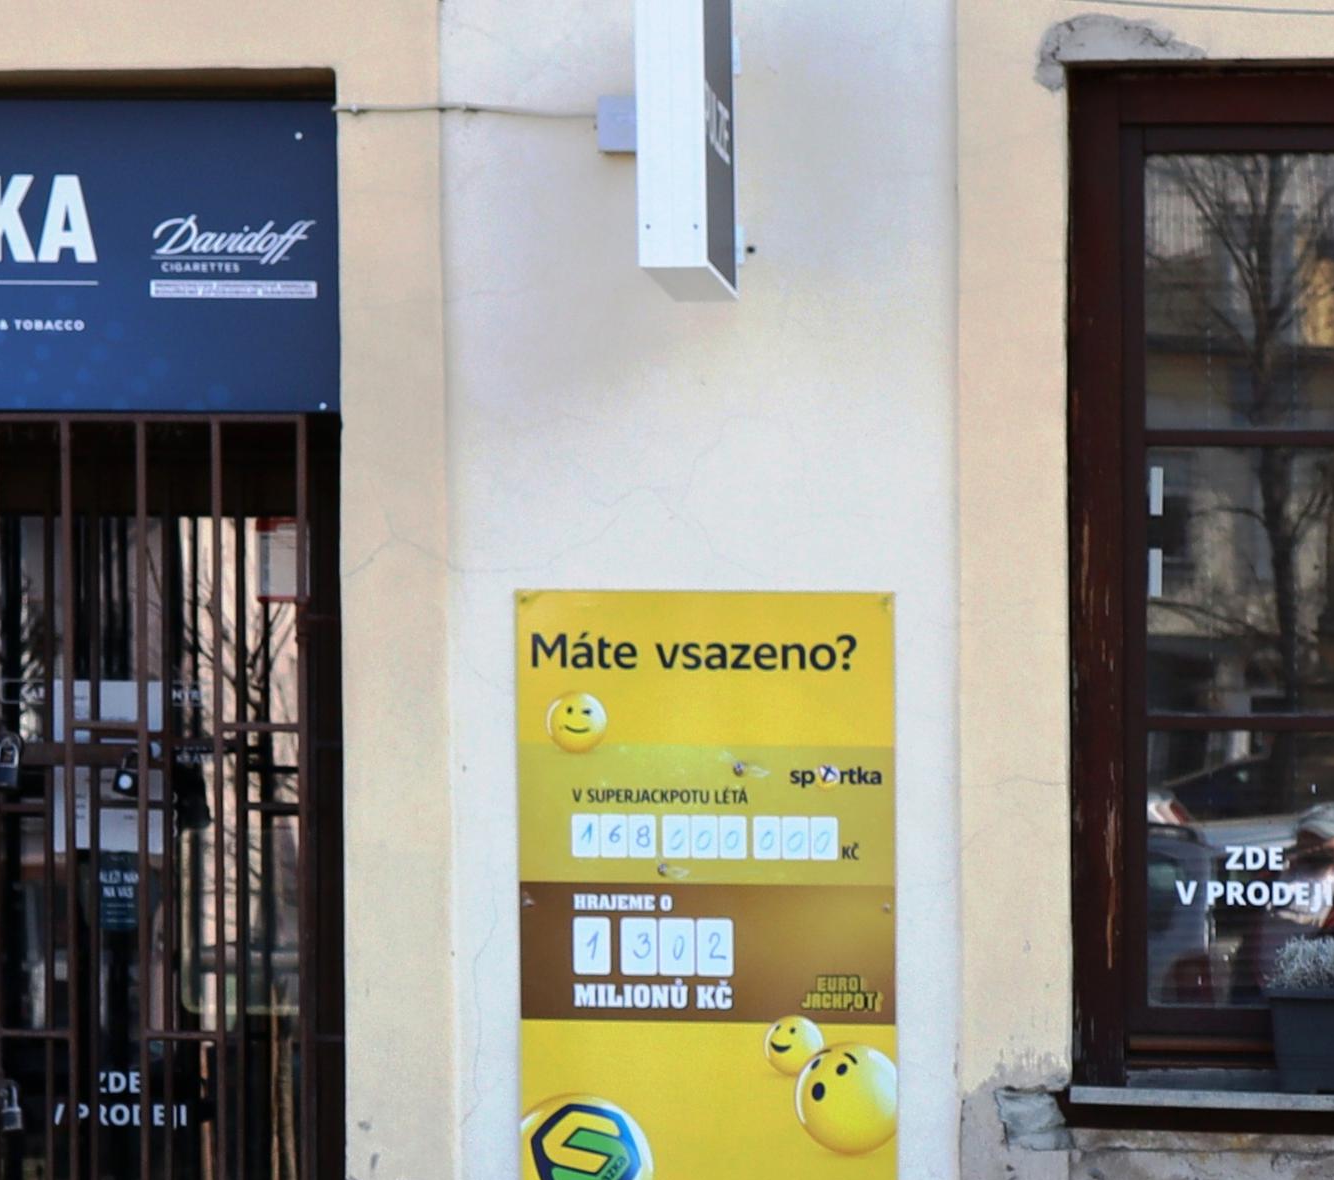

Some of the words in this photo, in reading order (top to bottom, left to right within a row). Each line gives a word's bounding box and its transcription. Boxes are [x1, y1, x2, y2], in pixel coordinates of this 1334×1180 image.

[152, 214, 317, 264] Davidoff
[161, 262, 241, 273] CIGARETTES
[0, 319, 9, 331] &
[15, 319, 85, 332] TOBACCO
[531, 632, 637, 671] Máte
[655, 635, 857, 672] vsazeno?
[572, 789, 582, 803] V
[587, 789, 710, 805] SUPERJACKPOTU
[715, 786, 749, 804] LÉTÁ
[842, 844, 860, 860] KČ
[1224, 845, 1284, 871] ZDE
[573, 894, 656, 911] HRAJEME
[660, 895, 673, 911] O
[1175, 880, 1198, 906] V
[1206, 880, 1334, 912] PRODEJI
[573, 977, 688, 1009] MILIONŮ
[696, 980, 733, 1010] KČ
